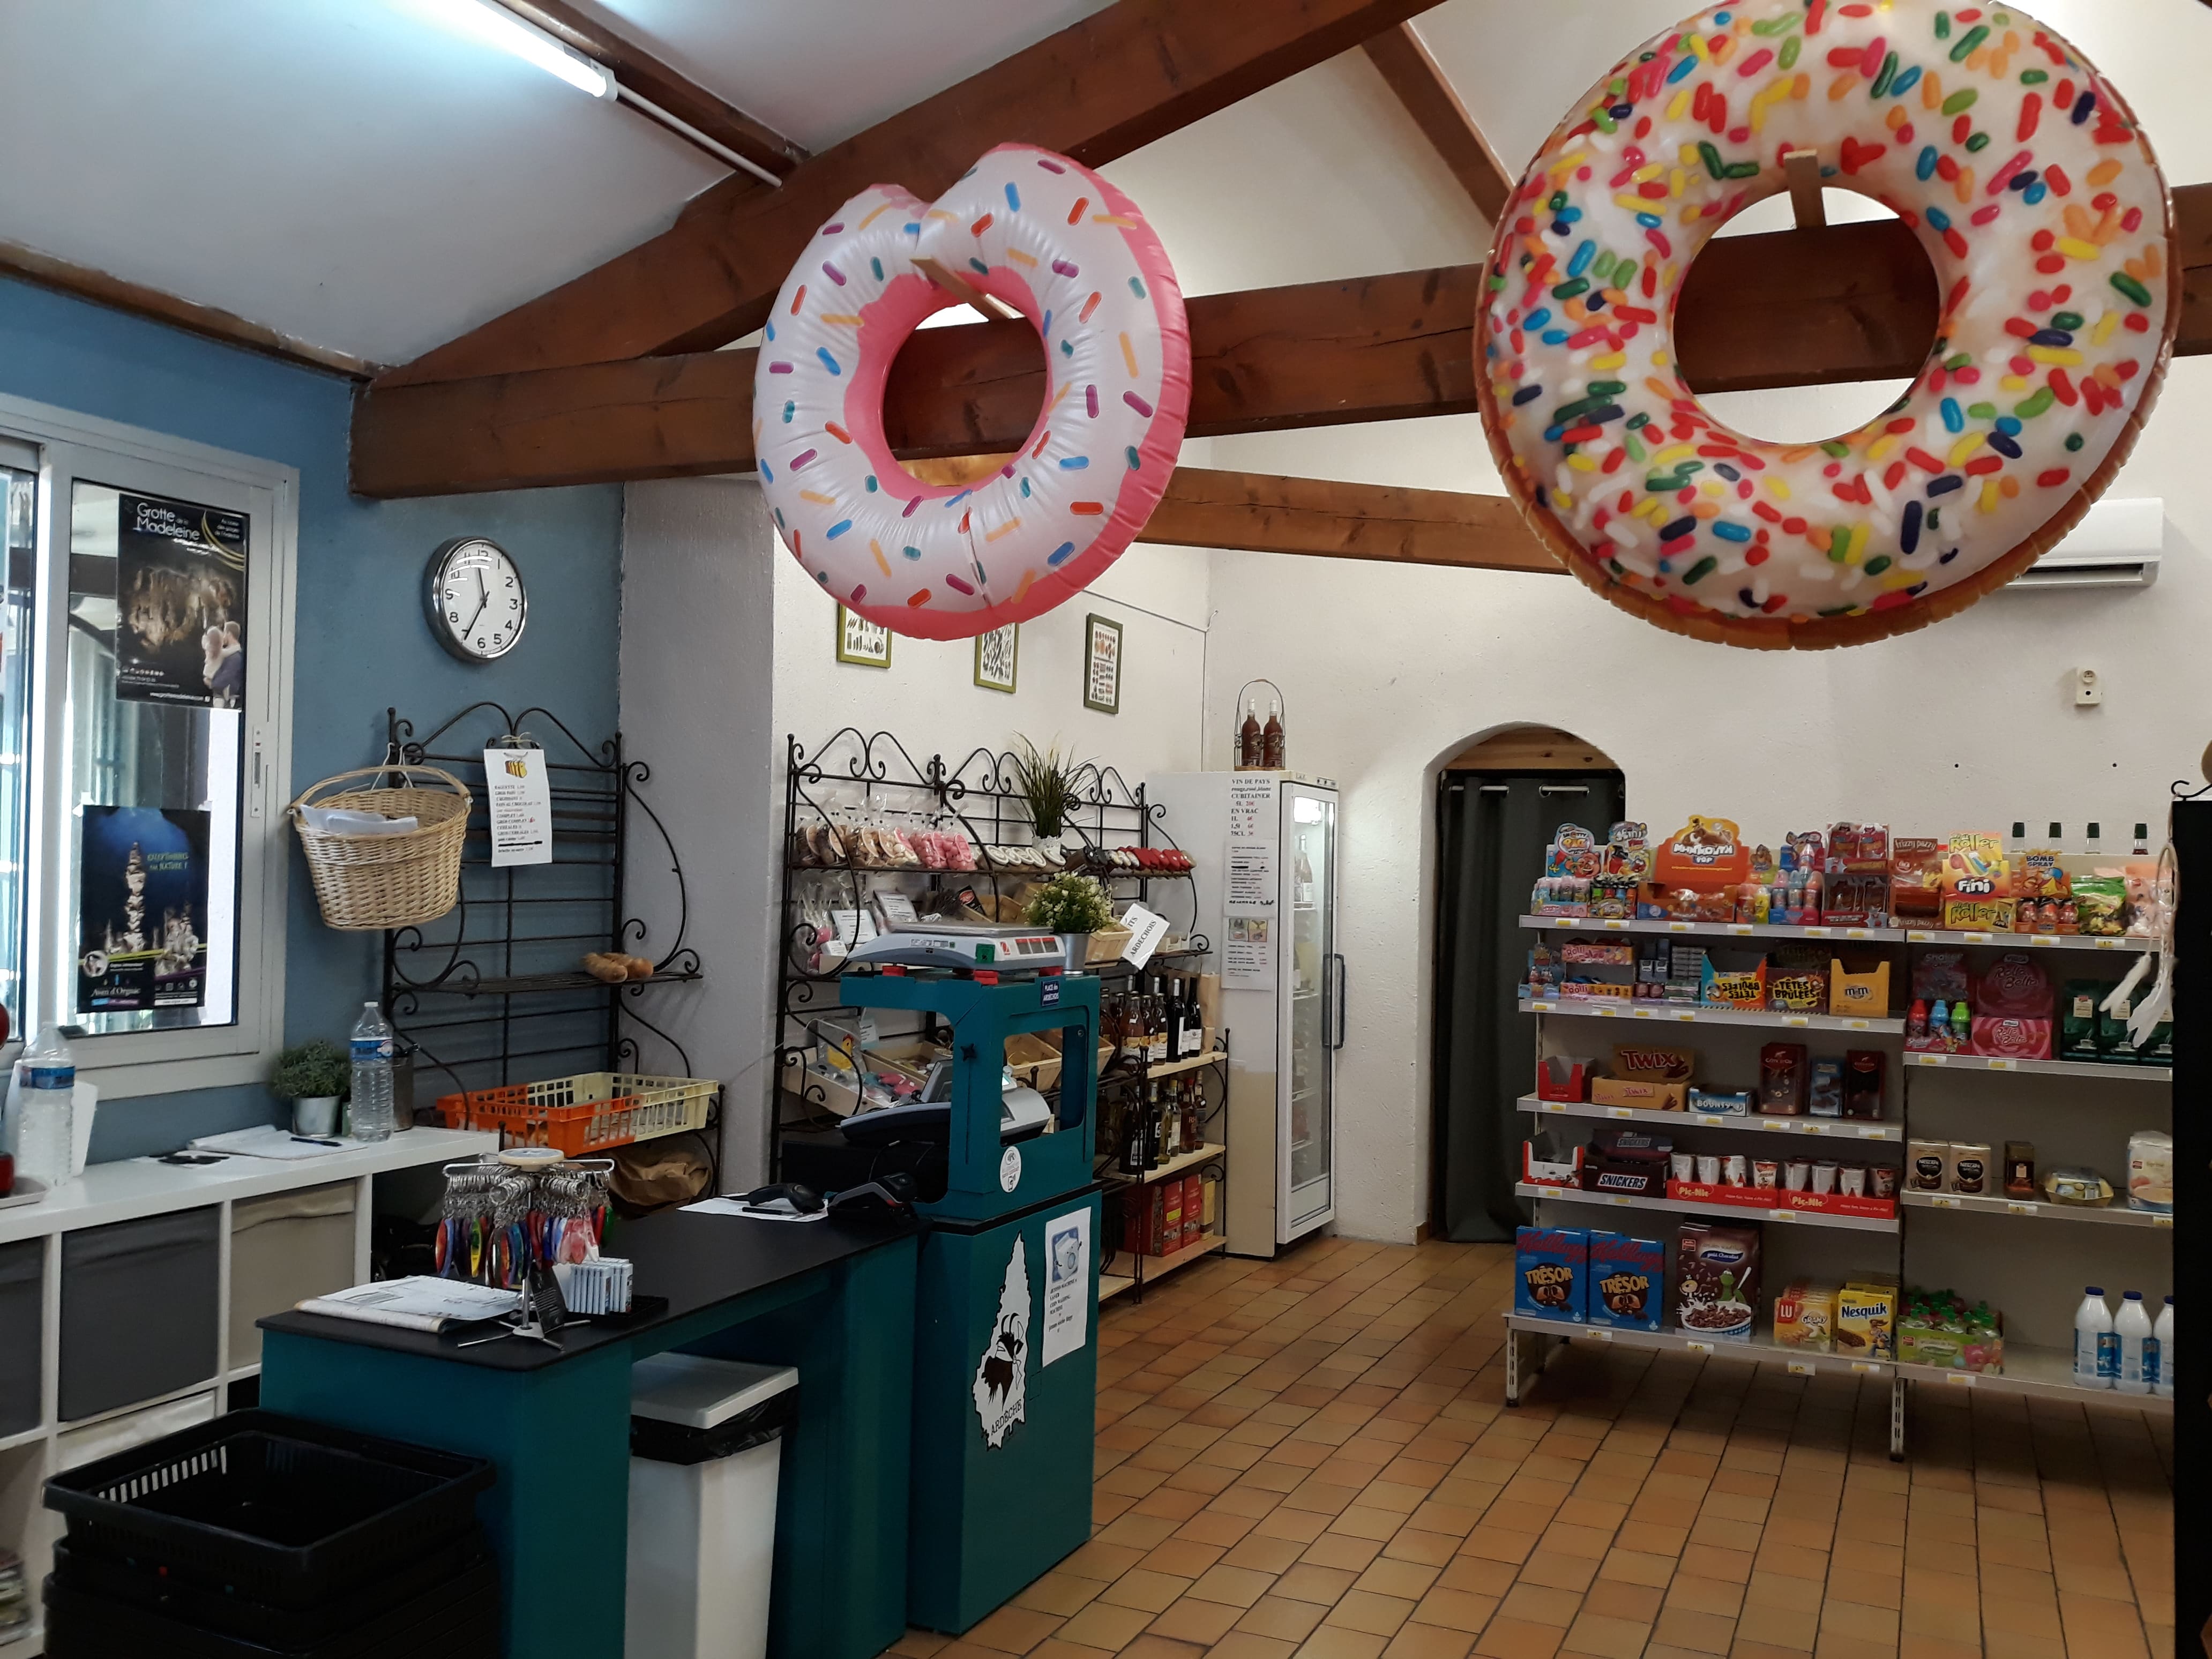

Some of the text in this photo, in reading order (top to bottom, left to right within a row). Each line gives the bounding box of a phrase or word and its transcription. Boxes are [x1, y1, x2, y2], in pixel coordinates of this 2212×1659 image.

[137, 516, 200, 541] Madeleine
[505, 577, 513, 587] 2
[445, 588, 454, 600] 9
[509, 599, 518, 610] 3
[449, 611, 459, 623] 8
[505, 619, 513, 631] 4
[477, 638, 485, 649] 6
[494, 633, 502, 645] 5
[1957, 878, 1990, 893] Fini
[1697, 1100, 1731, 1109] BOUNTY
[1600, 1174, 1647, 1189] SNICKERS
[1781, 1305, 1792, 1318] LU
[1842, 1302, 1887, 1320] Nesquik
